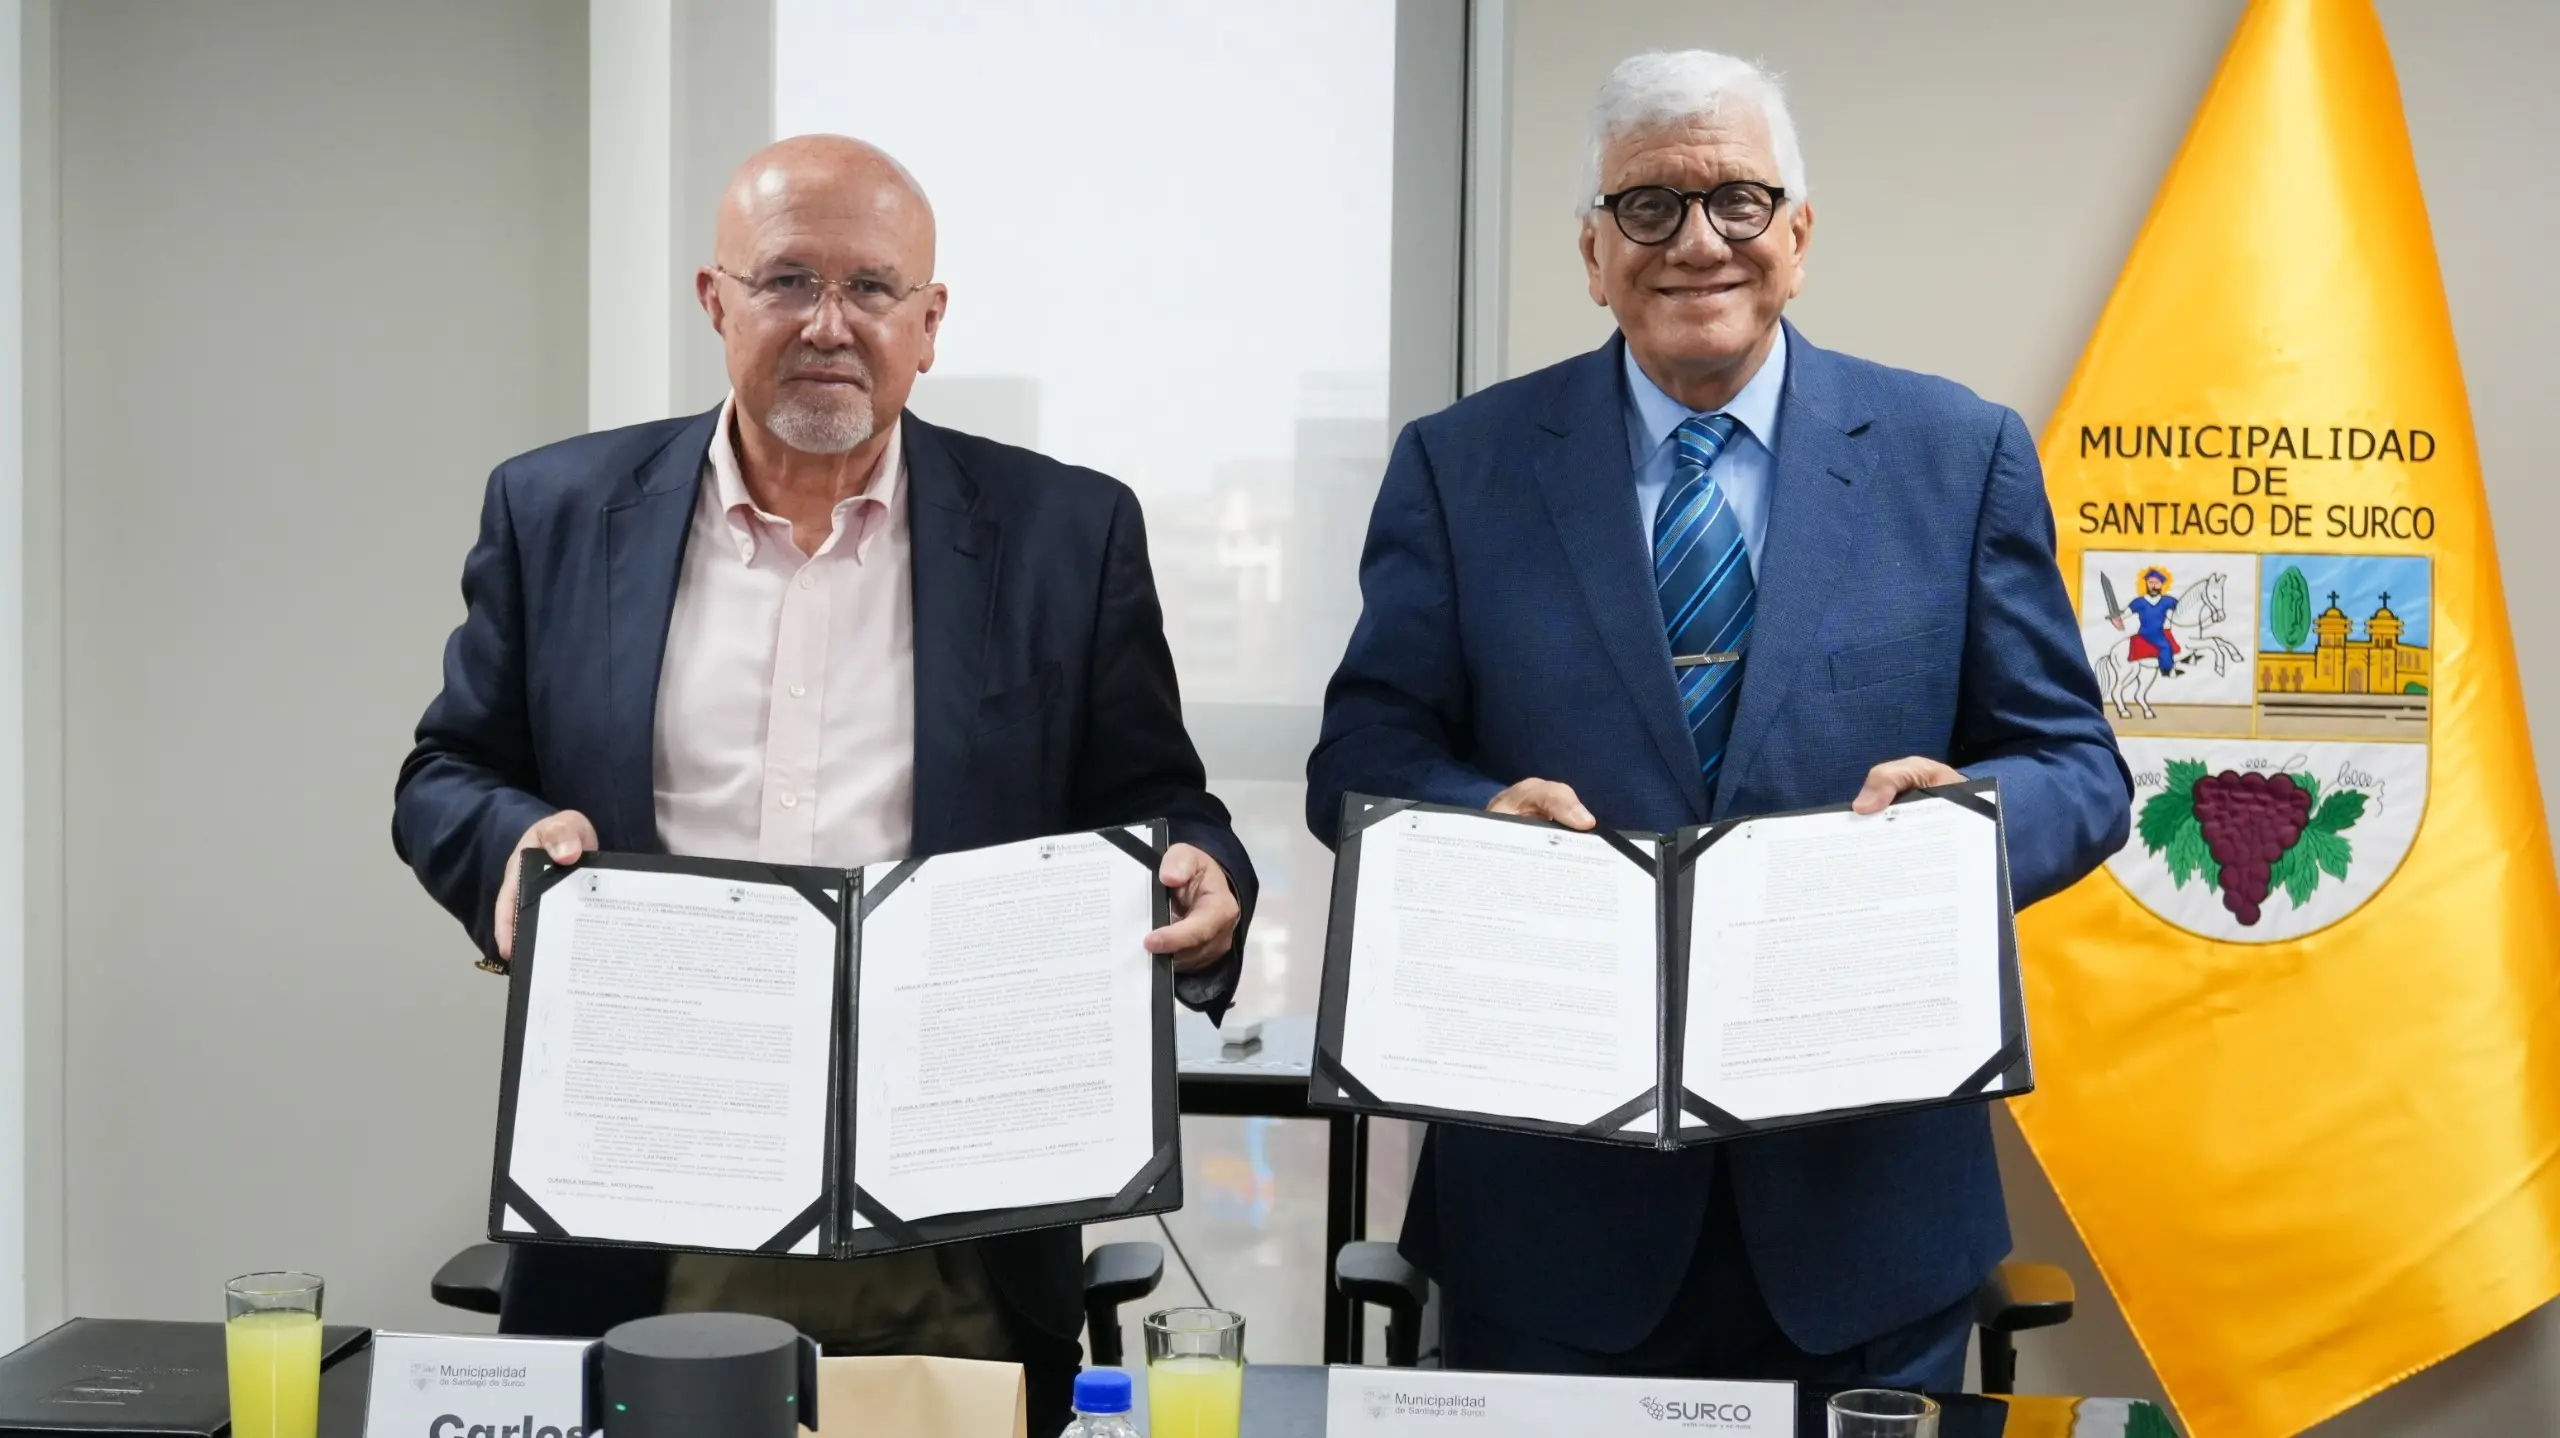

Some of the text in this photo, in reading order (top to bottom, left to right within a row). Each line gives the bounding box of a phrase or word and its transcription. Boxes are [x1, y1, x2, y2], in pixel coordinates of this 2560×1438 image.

[2080, 425, 2436, 463] MUNICIPALIDAD
[2232, 466, 2288, 497] DE
[2078, 502, 2435, 540] SANTIAGO DE SURCO
[440, 1364, 526, 1380] Municipalidad
[439, 1378, 525, 1388] de Santiago de Surco
[1395, 1391, 1486, 1408] Municipalidad
[1395, 1406, 1486, 1417] de Santiago de Surco
[1666, 1401, 1752, 1422] SURCO
